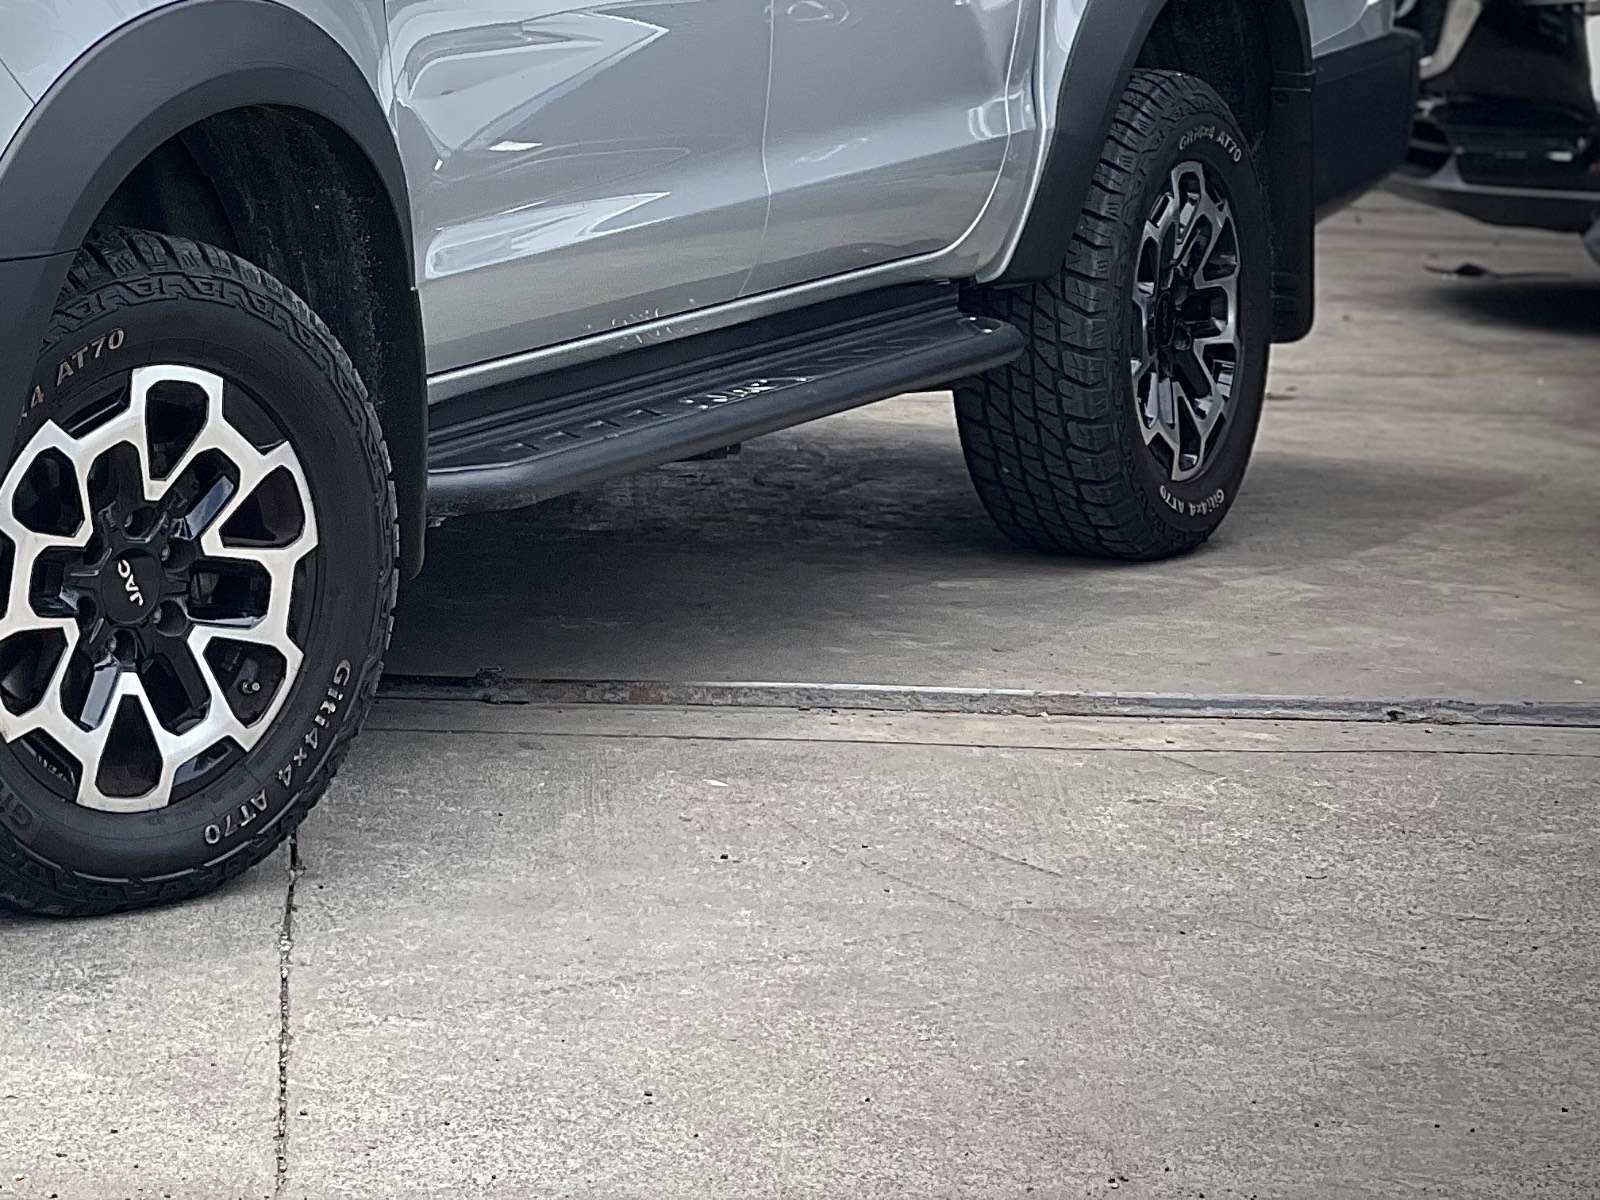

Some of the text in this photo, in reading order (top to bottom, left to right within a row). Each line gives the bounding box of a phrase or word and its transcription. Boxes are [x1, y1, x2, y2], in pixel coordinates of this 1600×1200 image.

[1216, 130, 1242, 162] AT70
[56, 327, 125, 387] AT70
[1160, 485, 1185, 514] AT70
[117, 559, 144, 606] JAC
[204, 658, 352, 845] Giti4x4 AT70
